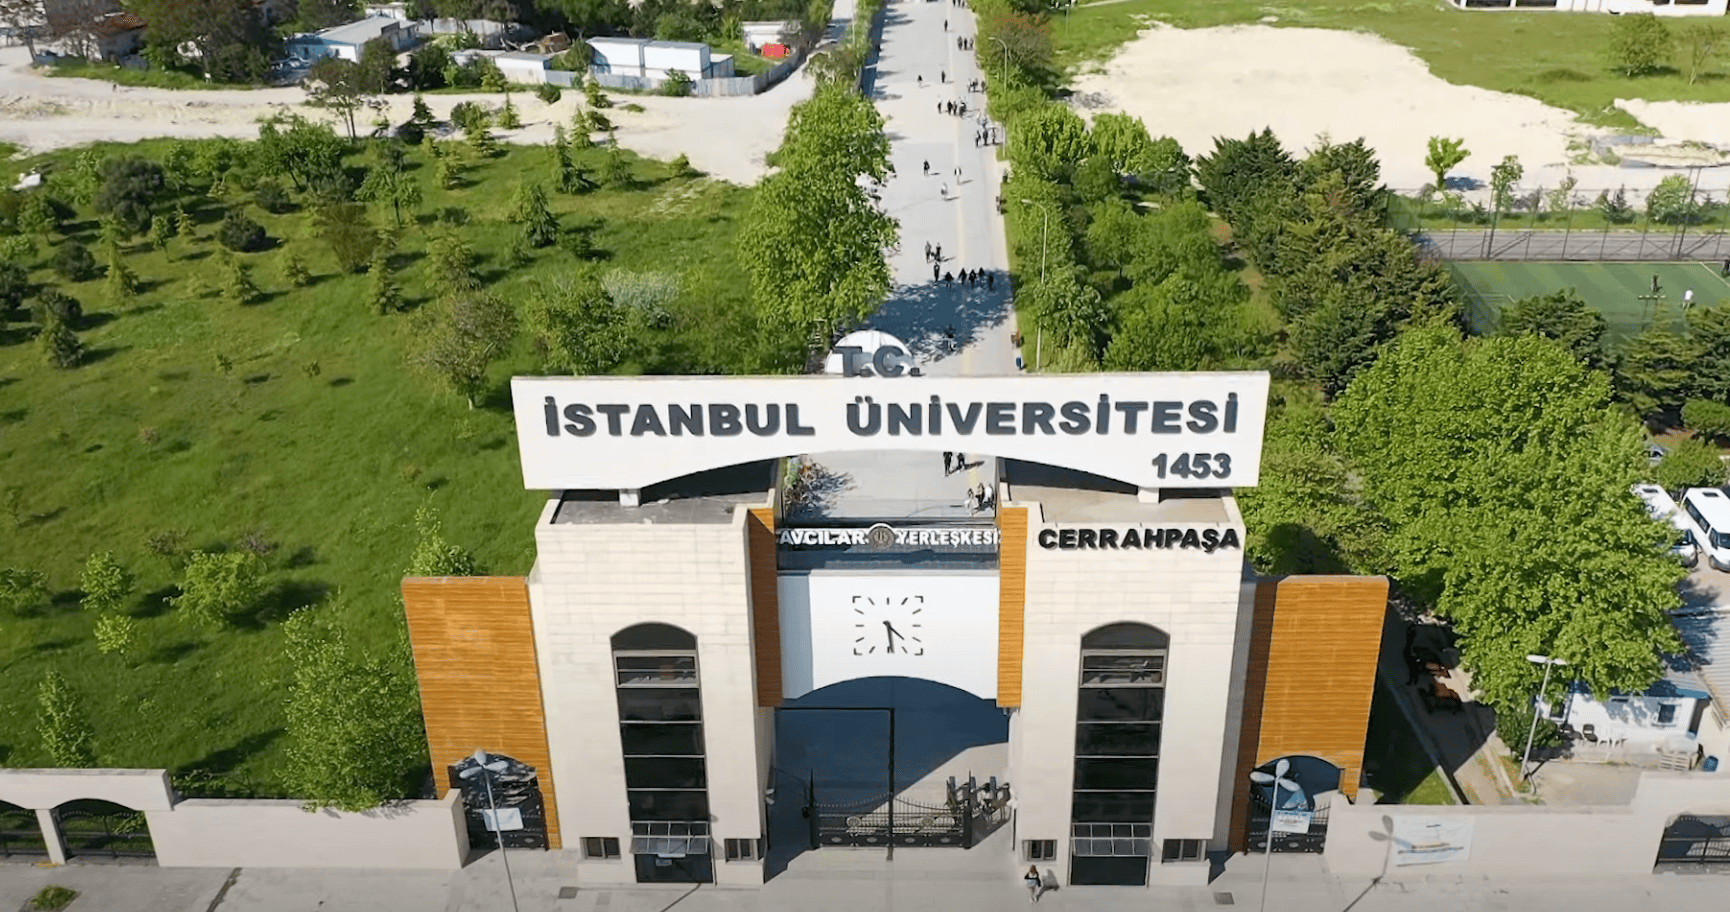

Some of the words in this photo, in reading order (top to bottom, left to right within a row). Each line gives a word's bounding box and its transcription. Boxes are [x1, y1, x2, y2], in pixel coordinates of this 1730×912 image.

[834, 345, 920, 378] T.C.
[544, 396, 816, 437] İSTANBUL
[846, 393, 1238, 436] ÜNİVERSİTESİ
[1151, 452, 1232, 480] 1453
[780, 530, 867, 545] AVCILAR
[1038, 528, 1240, 553] CERRAHPAŞA
